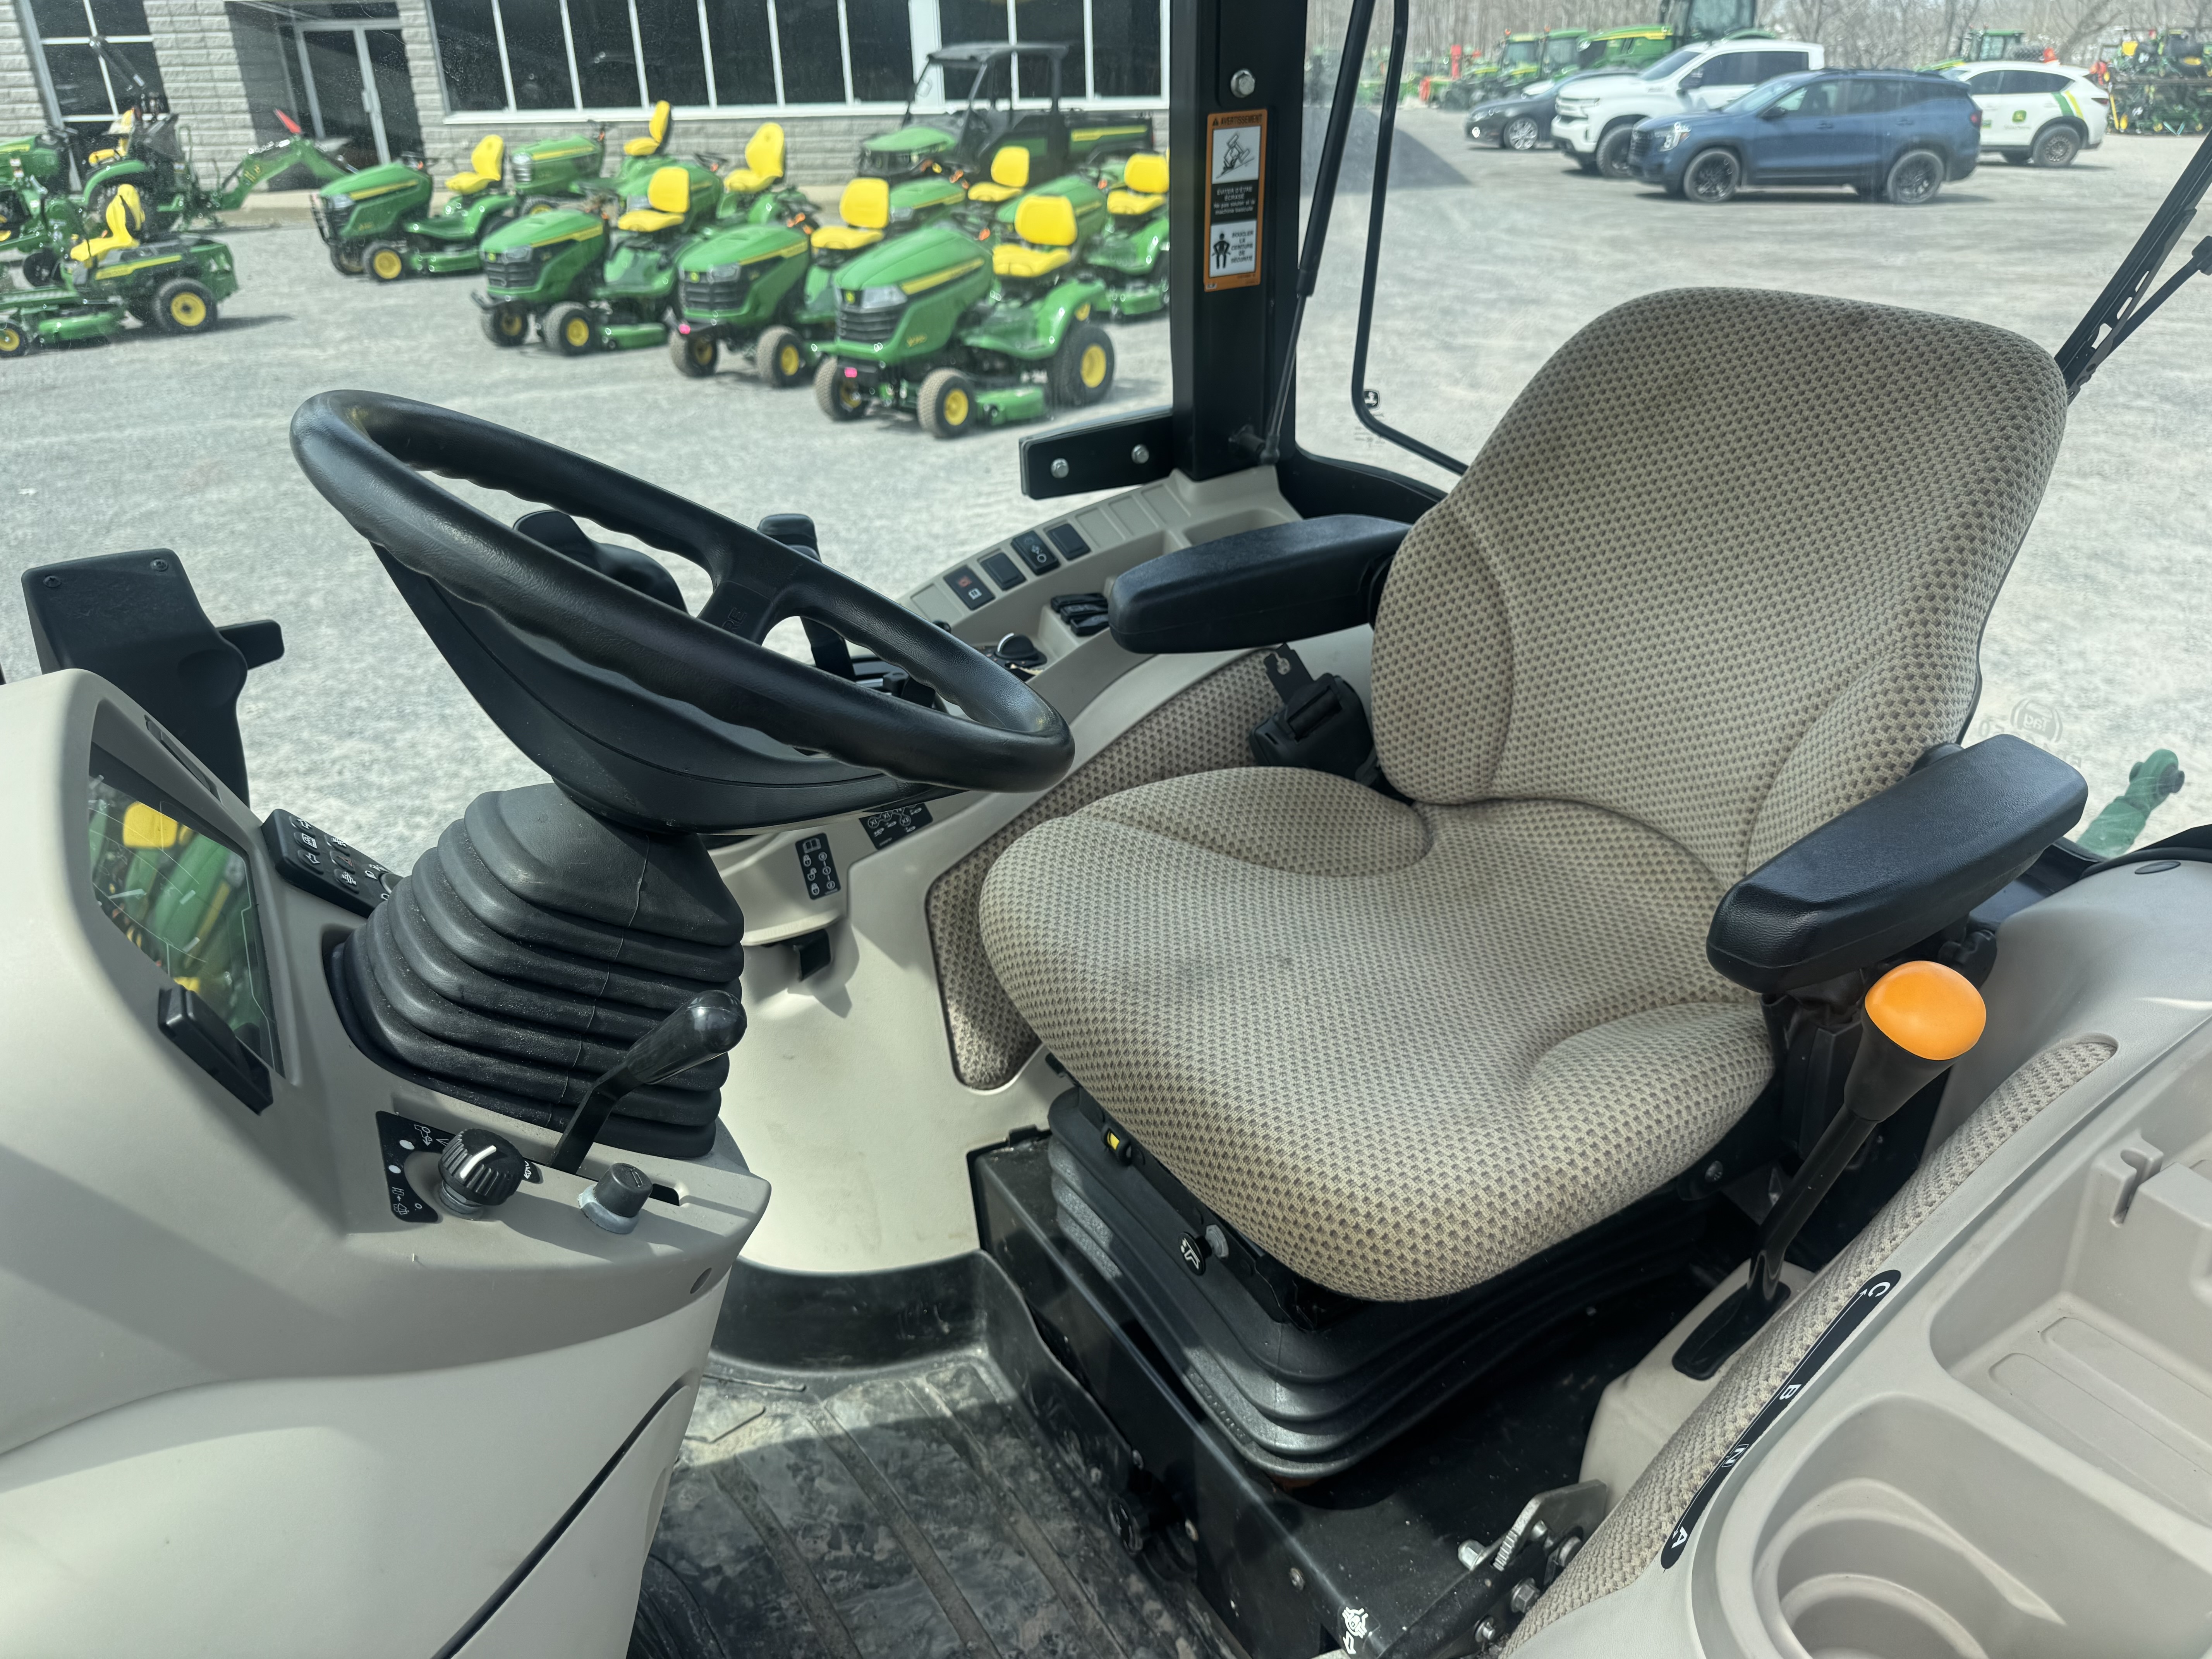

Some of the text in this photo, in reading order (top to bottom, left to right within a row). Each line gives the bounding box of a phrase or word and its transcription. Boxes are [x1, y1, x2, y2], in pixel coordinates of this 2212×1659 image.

[1221, 114, 1262, 125] AVERTISSEMENT
[1867, 1281, 1891, 1298] C
[1779, 1384, 1802, 1400] B
[1725, 1447, 1745, 1464] N
[1671, 1526, 1688, 1548] A
